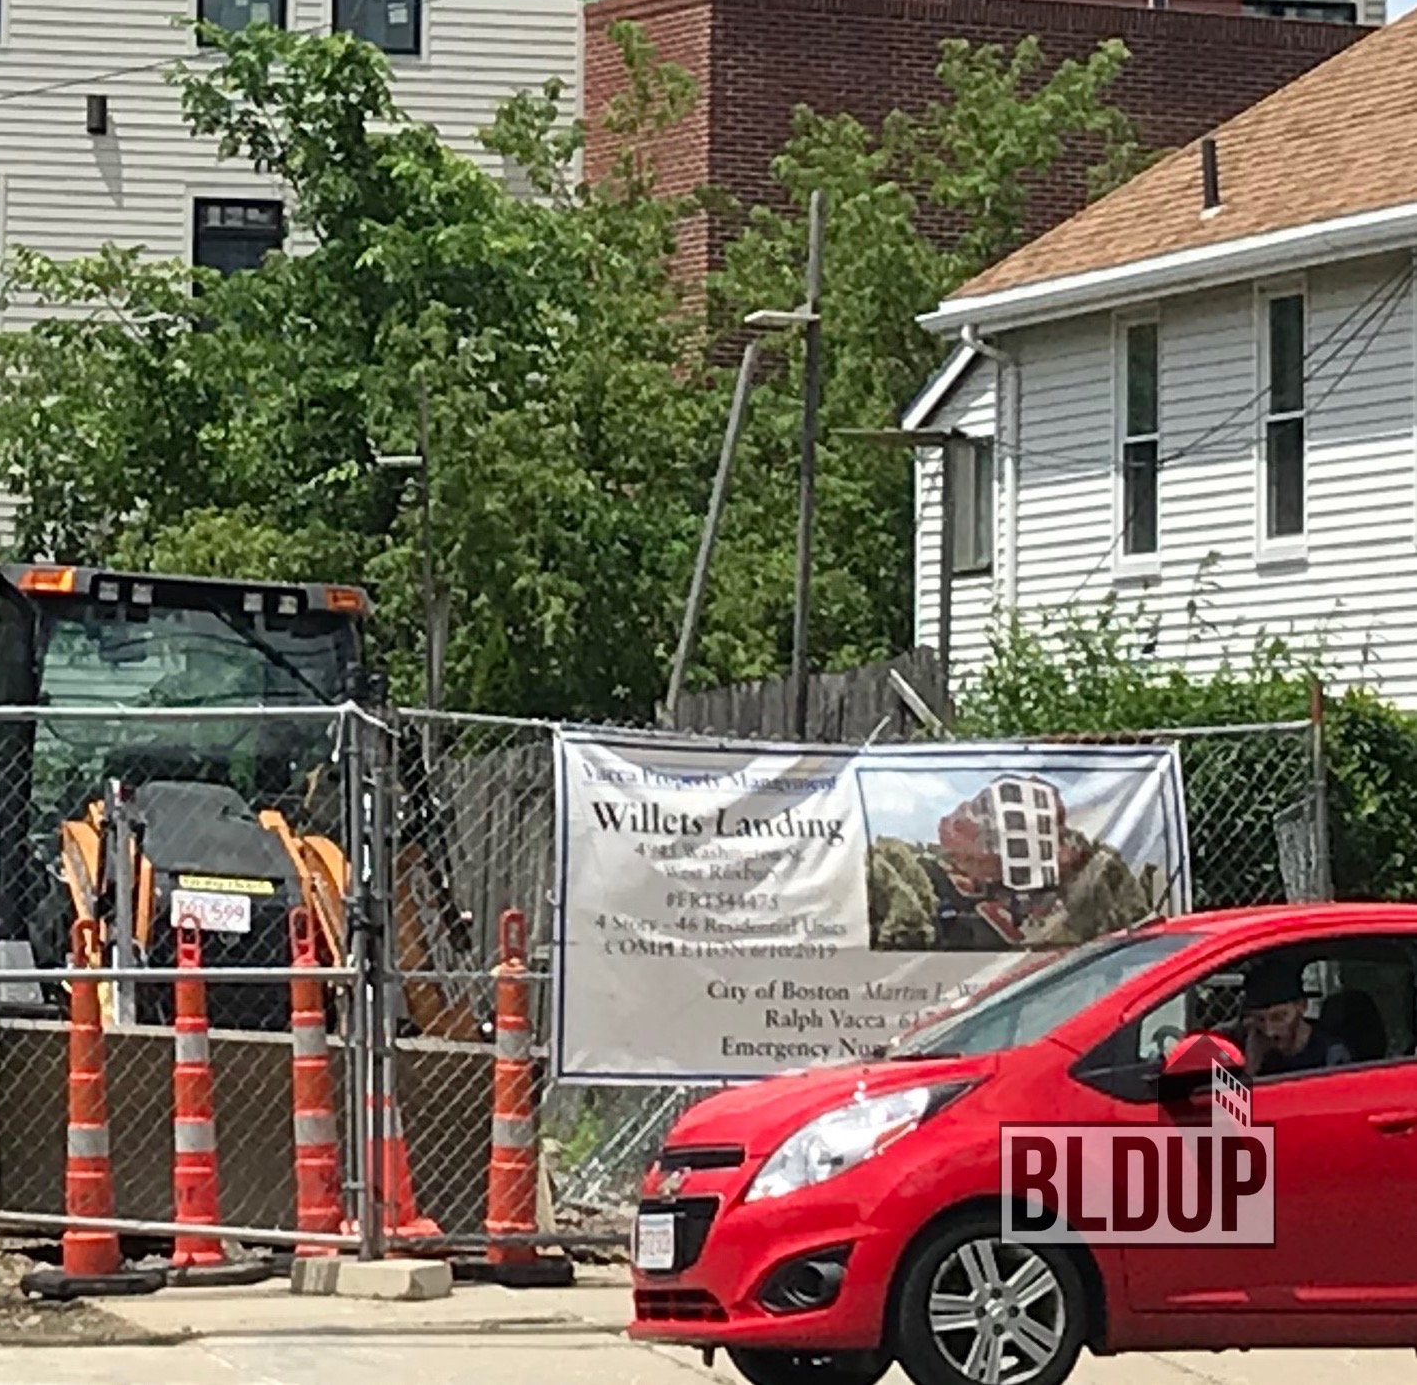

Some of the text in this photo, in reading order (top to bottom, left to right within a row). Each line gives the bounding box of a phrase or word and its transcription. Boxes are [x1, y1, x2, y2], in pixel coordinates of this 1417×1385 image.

[591, 801, 845, 846] Willets Landing
[707, 980, 749, 1004] City
[754, 979, 777, 1000] of
[782, 980, 850, 1001] Boston
[863, 981, 928, 1001] Martin
[765, 1007, 823, 1032] Ralph
[829, 1008, 885, 1029] Vacca
[721, 1035, 832, 1062] Emergency
